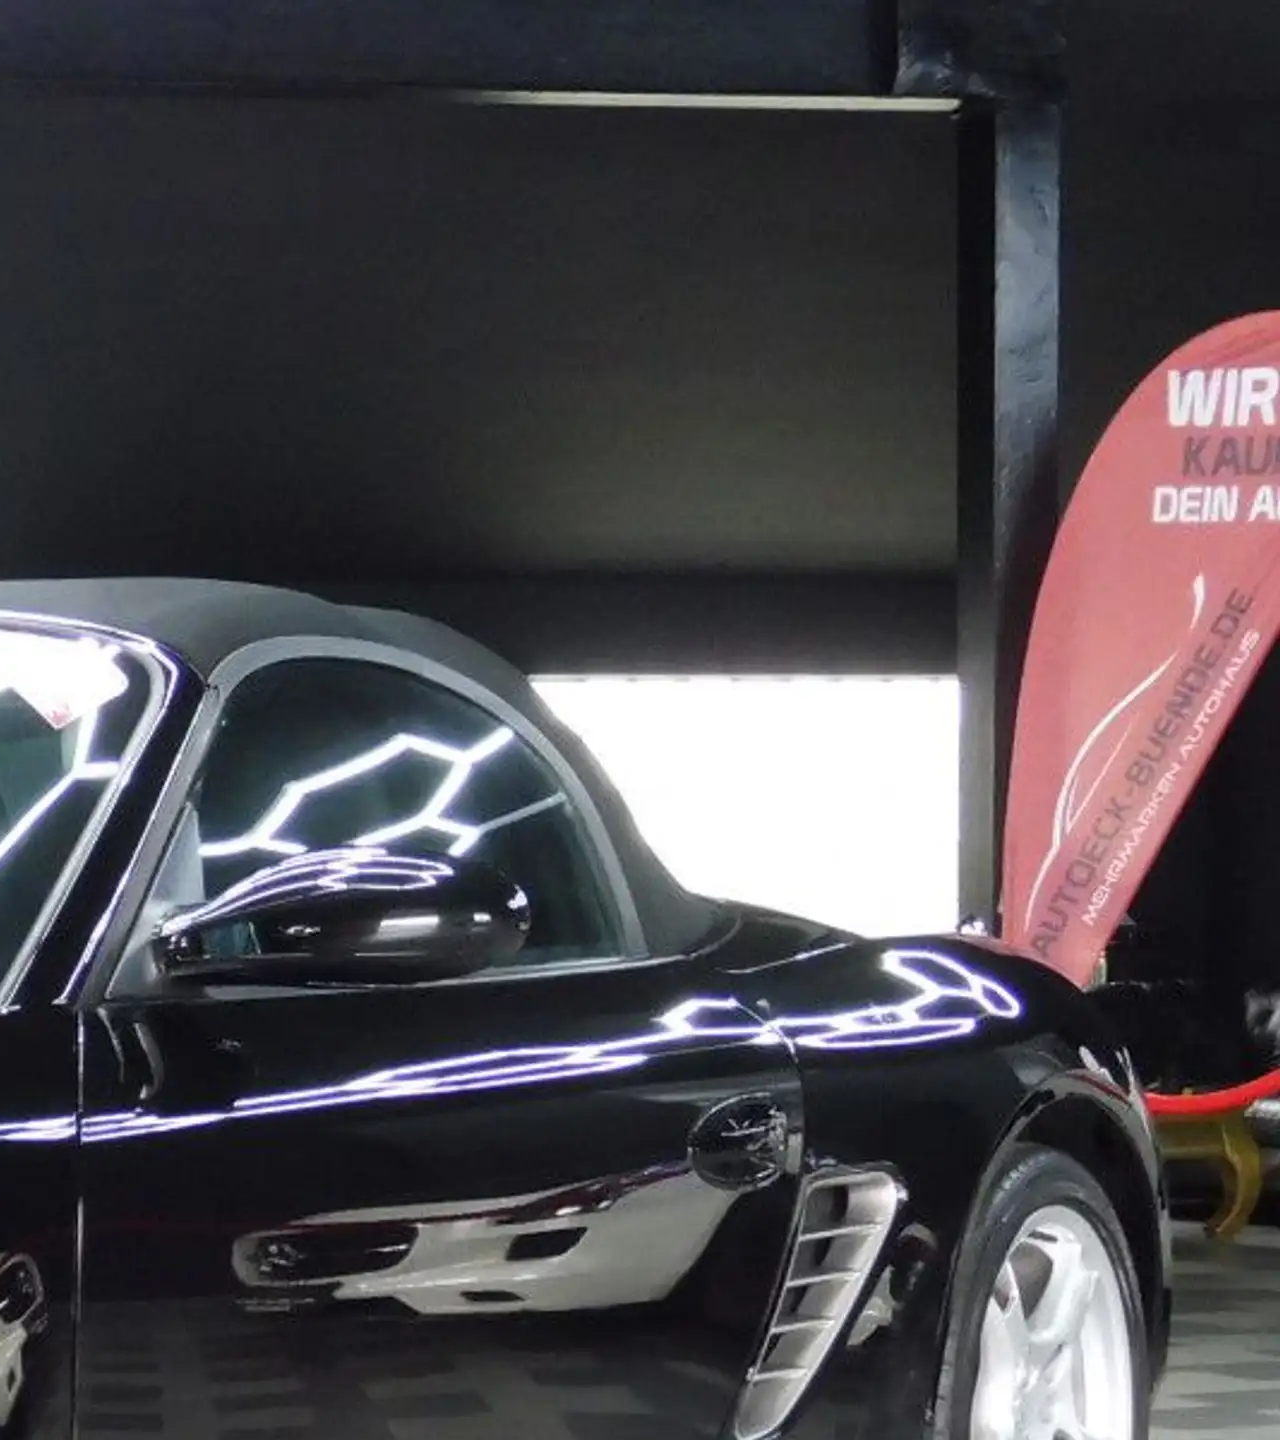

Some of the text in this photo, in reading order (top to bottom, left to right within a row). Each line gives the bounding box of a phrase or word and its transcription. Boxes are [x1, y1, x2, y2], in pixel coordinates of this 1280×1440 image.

[1167, 367, 1279, 428] WIR
[1182, 435, 1280, 477] KAU
[1152, 484, 1280, 524] DEIN A
[1030, 586, 1254, 959] AUTOECK-BUENDE.DE
[1082, 628, 1261, 927] MEHRMARKEN AUTOHAUS
